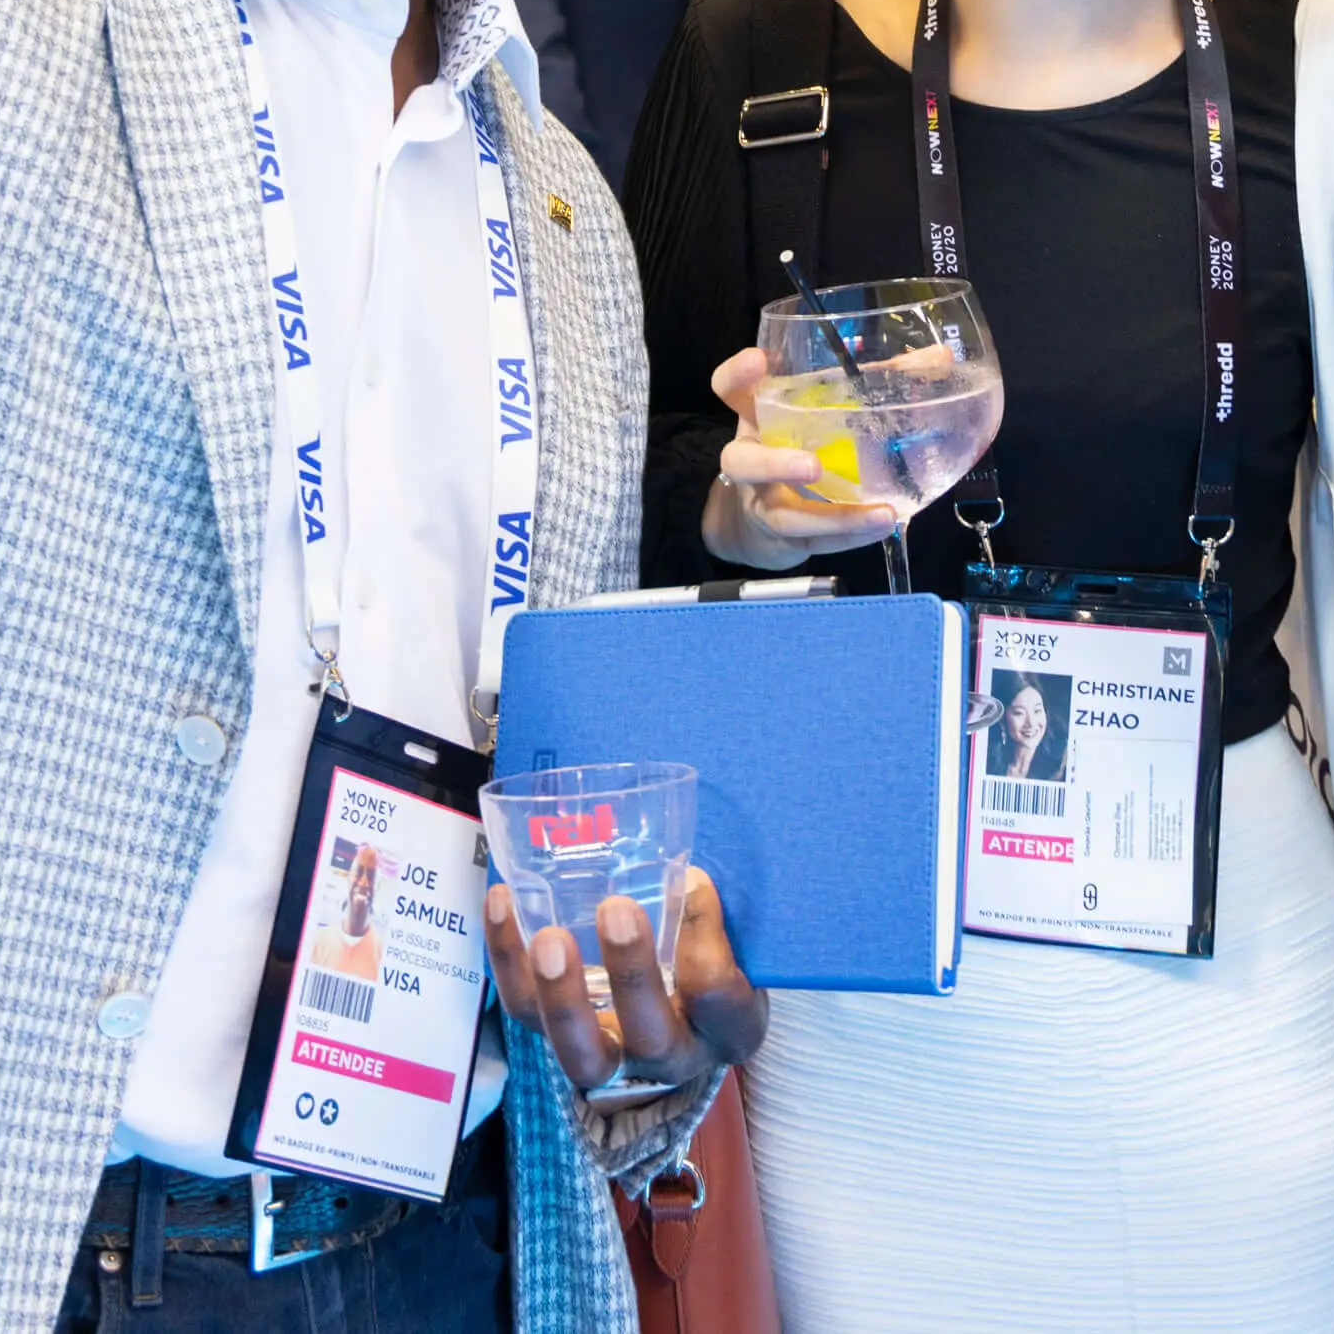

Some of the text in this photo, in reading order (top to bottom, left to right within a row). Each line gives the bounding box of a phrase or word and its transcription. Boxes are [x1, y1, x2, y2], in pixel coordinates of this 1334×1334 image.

[252, 102, 284, 204] VISA
[486, 218, 517, 303] VISA
[931, 222, 946, 275] MONEY
[943, 225, 958, 274] 20/20
[1209, 235, 1222, 290] MONEY
[1221, 240, 1234, 290] 20/20
[272, 261, 311, 370] VISA
[1216, 342, 1233, 422] thredd
[498, 358, 532, 453] VISA
[297, 430, 326, 544] VISA
[491, 511, 531, 617] VISA
[994, 645, 1051, 662] 20/20
[995, 630, 1059, 648] MONEY
[1077, 680, 1196, 704] CHRISTIANE
[1075, 709, 1140, 730] ZHAO
[340, 806, 388, 833] 20/20
[343, 788, 397, 818] MONEY
[528, 804, 613, 847] rai
[988, 835, 1074, 859] ATTENDE
[401, 863, 438, 890] JOE
[396, 896, 468, 936] SAMUEL
[383, 966, 420, 995] VISA
[386, 946, 481, 984] PROCESSING SALES
[297, 1039, 385, 1079] ATTENDEE
